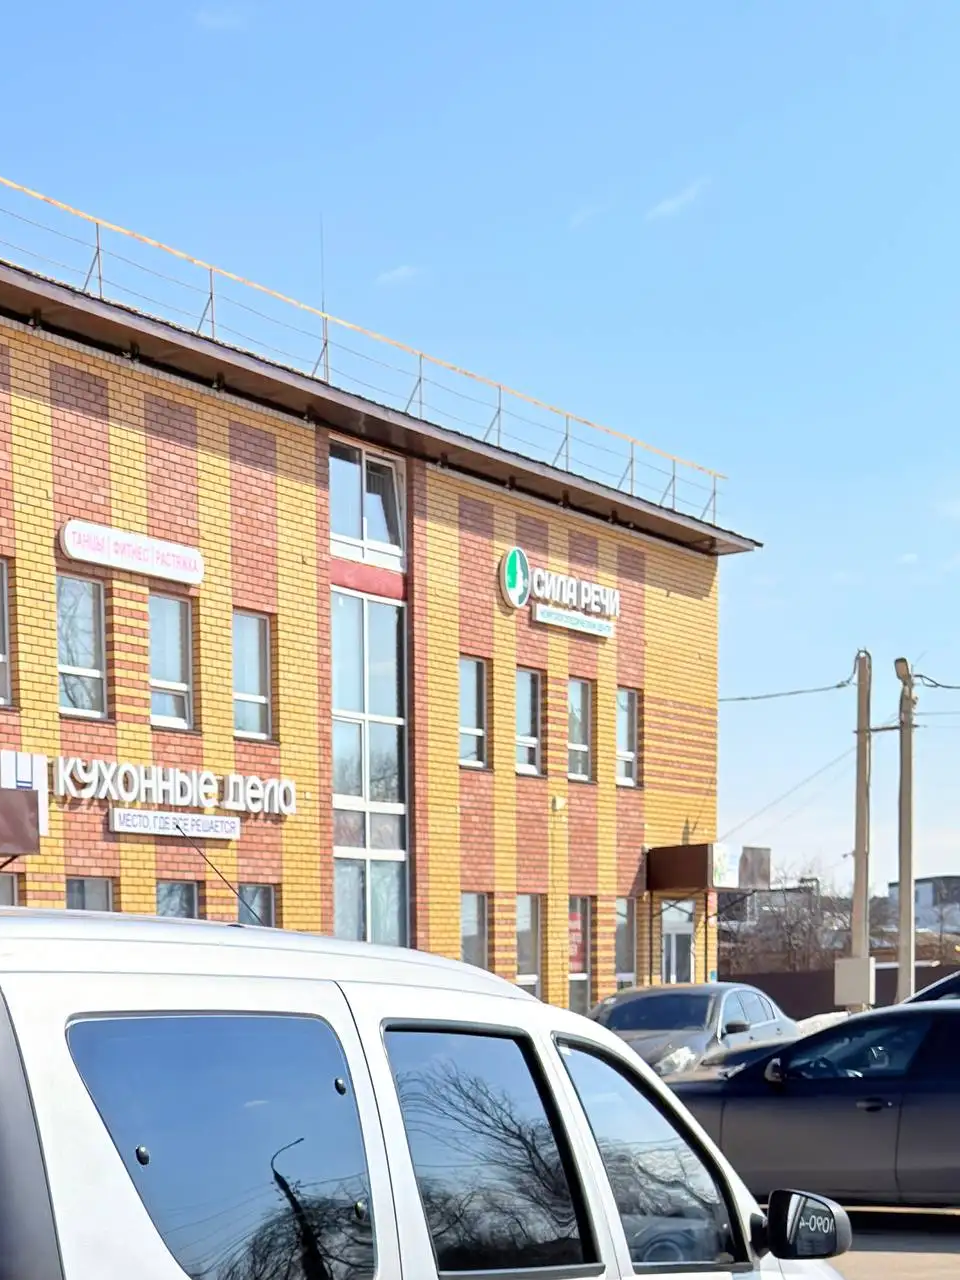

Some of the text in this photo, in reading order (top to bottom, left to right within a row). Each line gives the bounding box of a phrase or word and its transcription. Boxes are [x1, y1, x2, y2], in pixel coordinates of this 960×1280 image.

[533, 567, 620, 617] СИЛА РЕЧИ
[153, 815, 170, 831] ГДЕ
[191, 818, 236, 834] РЕШАЕТСЯ
